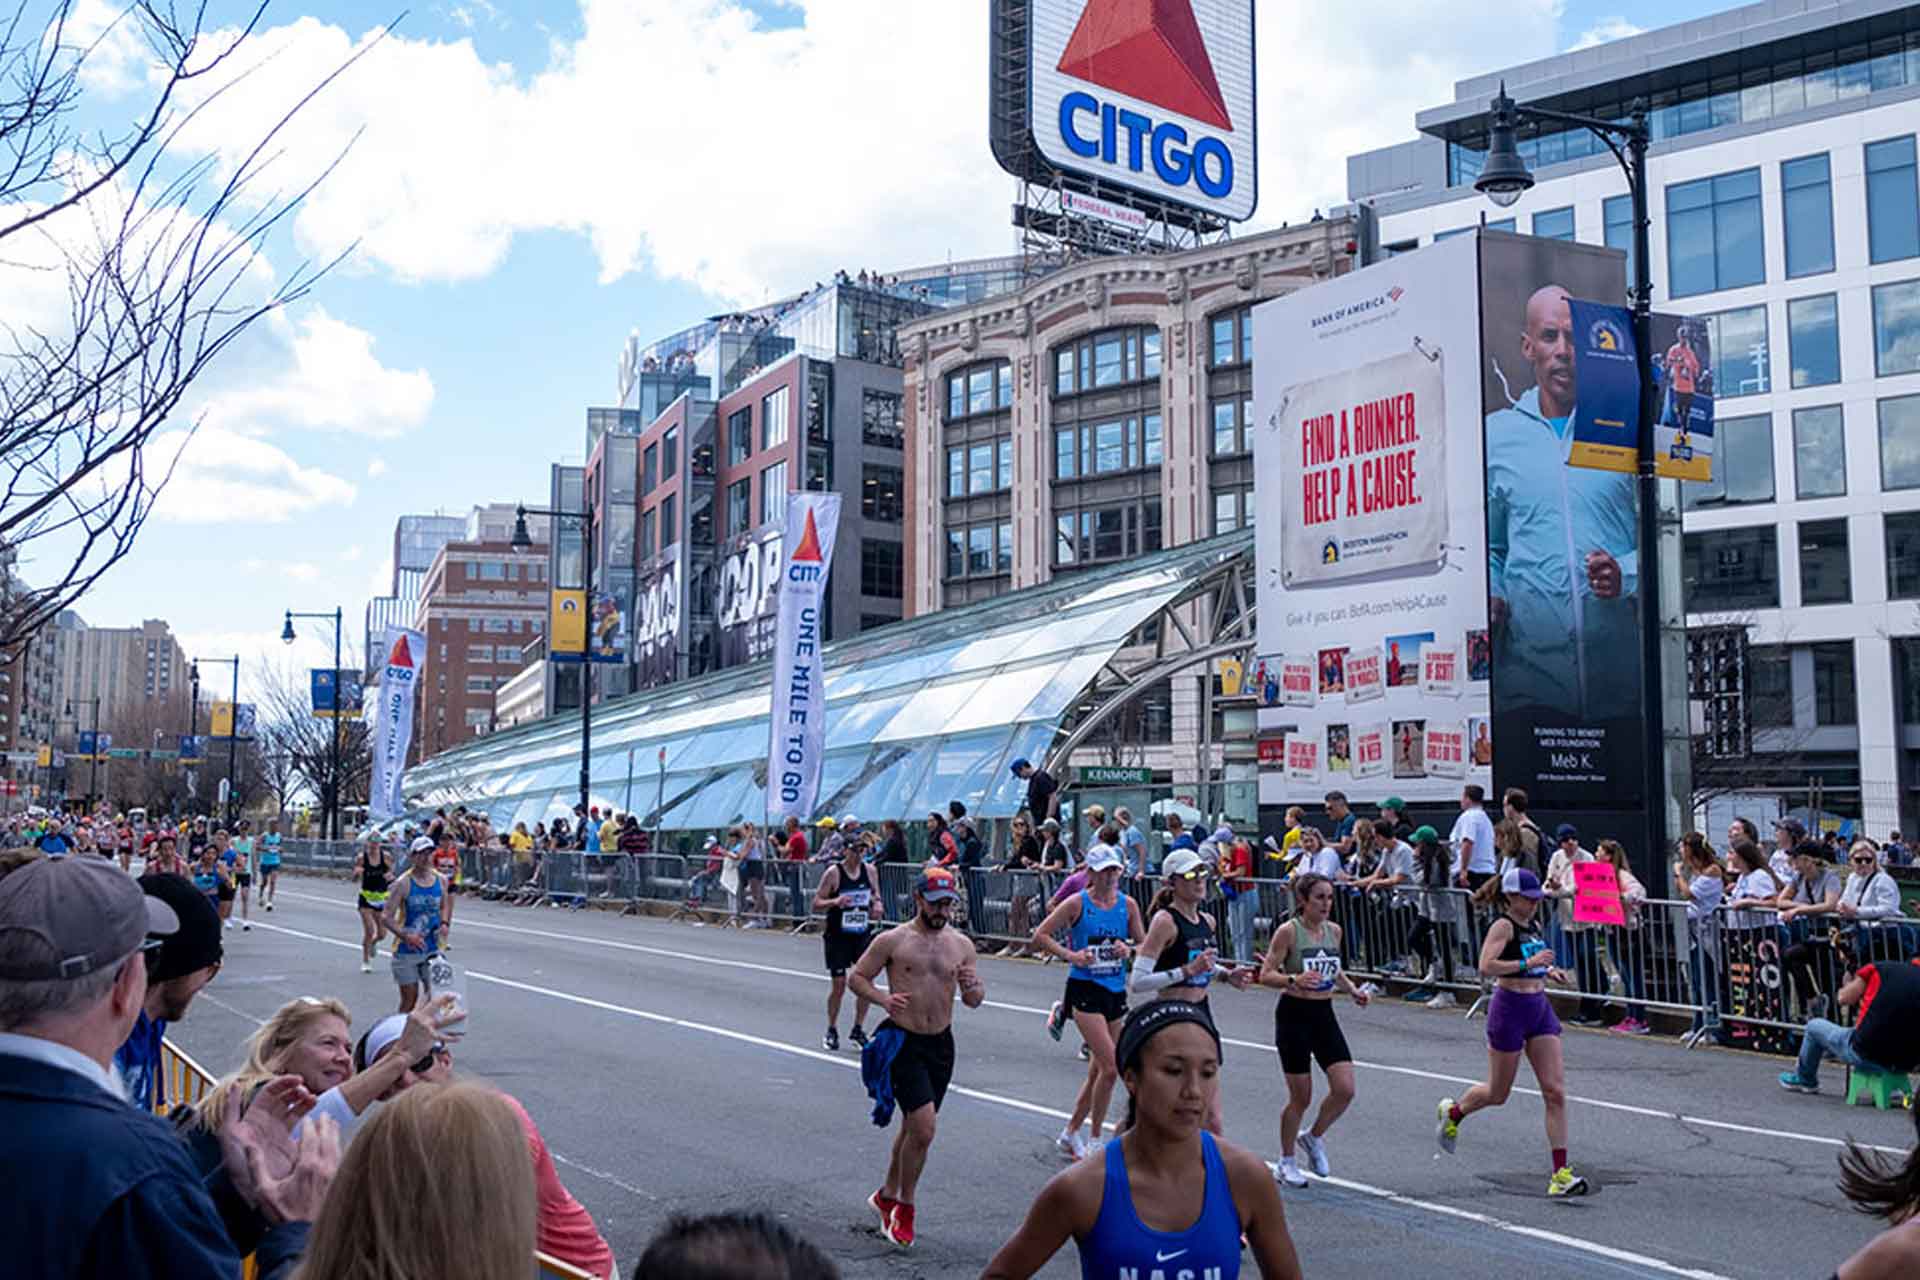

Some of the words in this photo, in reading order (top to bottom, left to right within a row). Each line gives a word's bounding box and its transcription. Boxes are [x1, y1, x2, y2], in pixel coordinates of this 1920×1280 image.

[1058, 91, 1233, 199] CITGO
[1311, 313, 1333, 328] BANK
[1335, 309, 1345, 321] OF
[1347, 297, 1385, 316] AMERICA
[1302, 413, 1335, 467] FIND
[1339, 410, 1349, 459] A
[1354, 392, 1420, 455] RUNNER.
[1303, 467, 1341, 527] HELP
[1346, 463, 1357, 518] A
[1362, 449, 1422, 514] CAUSE.
[788, 665, 811, 726] MILE
[786, 734, 804, 765] TO
[781, 771, 802, 803] GO
[1087, 769, 1144, 781] KENMORE
